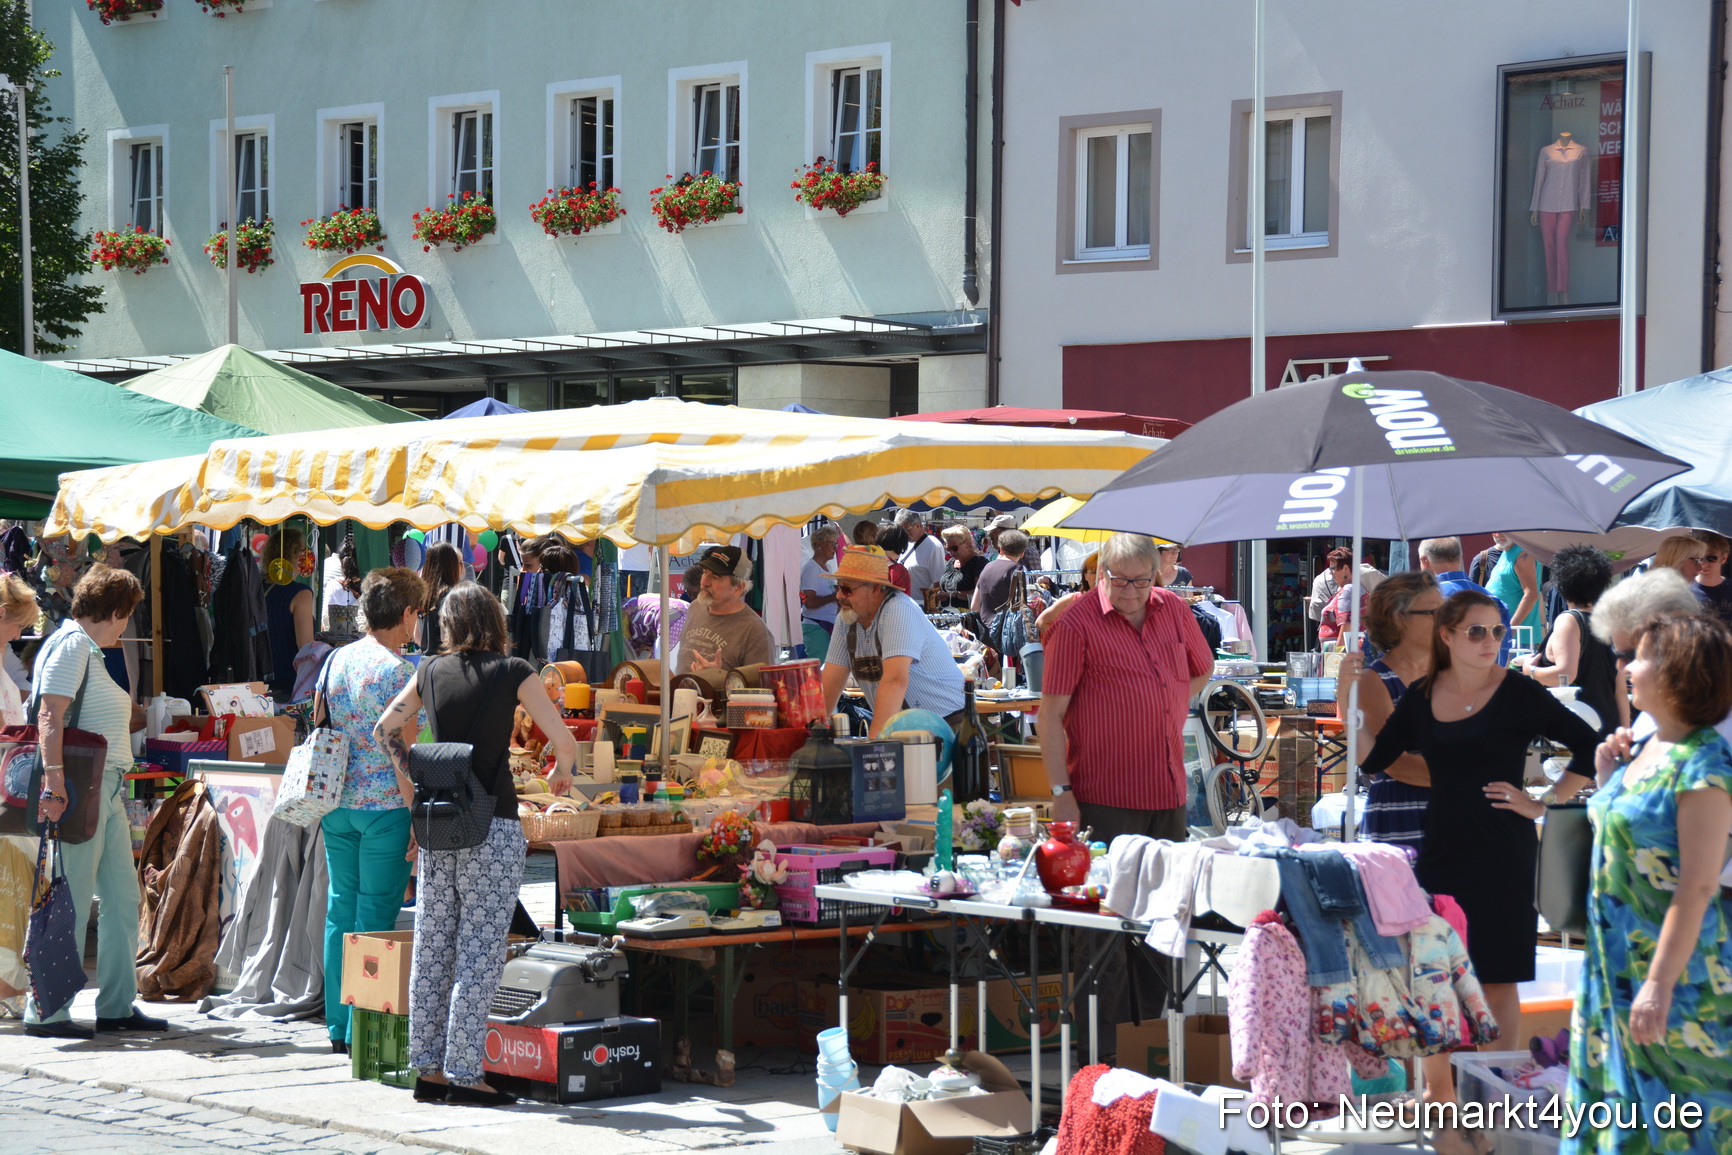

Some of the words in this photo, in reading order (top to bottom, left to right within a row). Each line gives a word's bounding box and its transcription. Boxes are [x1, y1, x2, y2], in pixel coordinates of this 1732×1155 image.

[1540, 95, 1585, 110] Achatz
[1602, 98, 1621, 116] WÄ
[1600, 121, 1621, 136] SCH
[300, 274, 426, 334] RENO
[1364, 389, 1453, 450] now
[1142, 422, 1166, 438] Achatz
[1394, 445, 1456, 456] drinknow.de
[686, 627, 727, 649] COASTLINE
